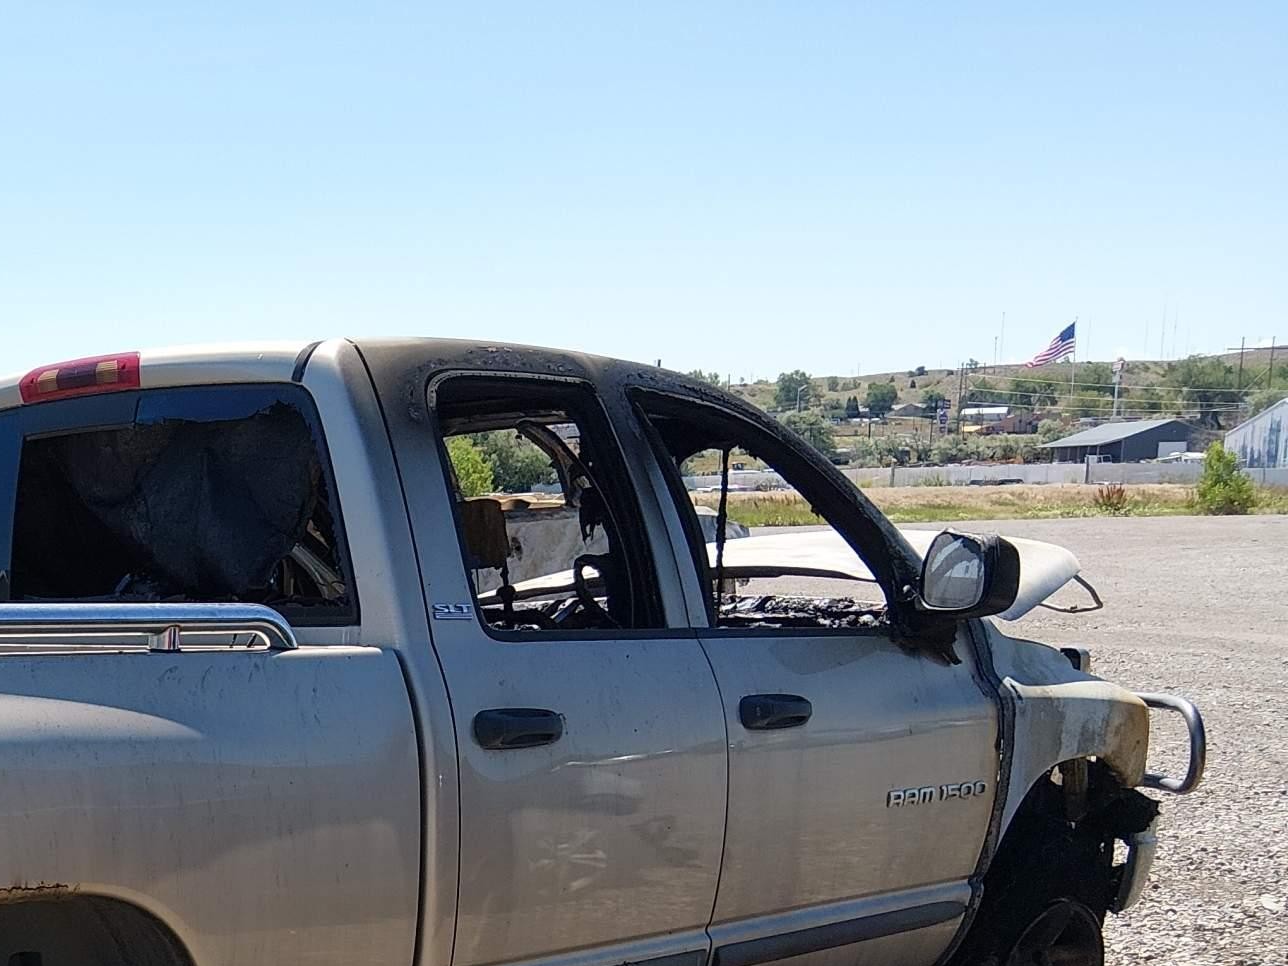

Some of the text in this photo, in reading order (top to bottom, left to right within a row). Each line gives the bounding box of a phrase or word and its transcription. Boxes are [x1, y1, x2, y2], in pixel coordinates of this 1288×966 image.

[432, 602, 472, 613] SLT
[887, 780, 987, 808] RAM 1500
